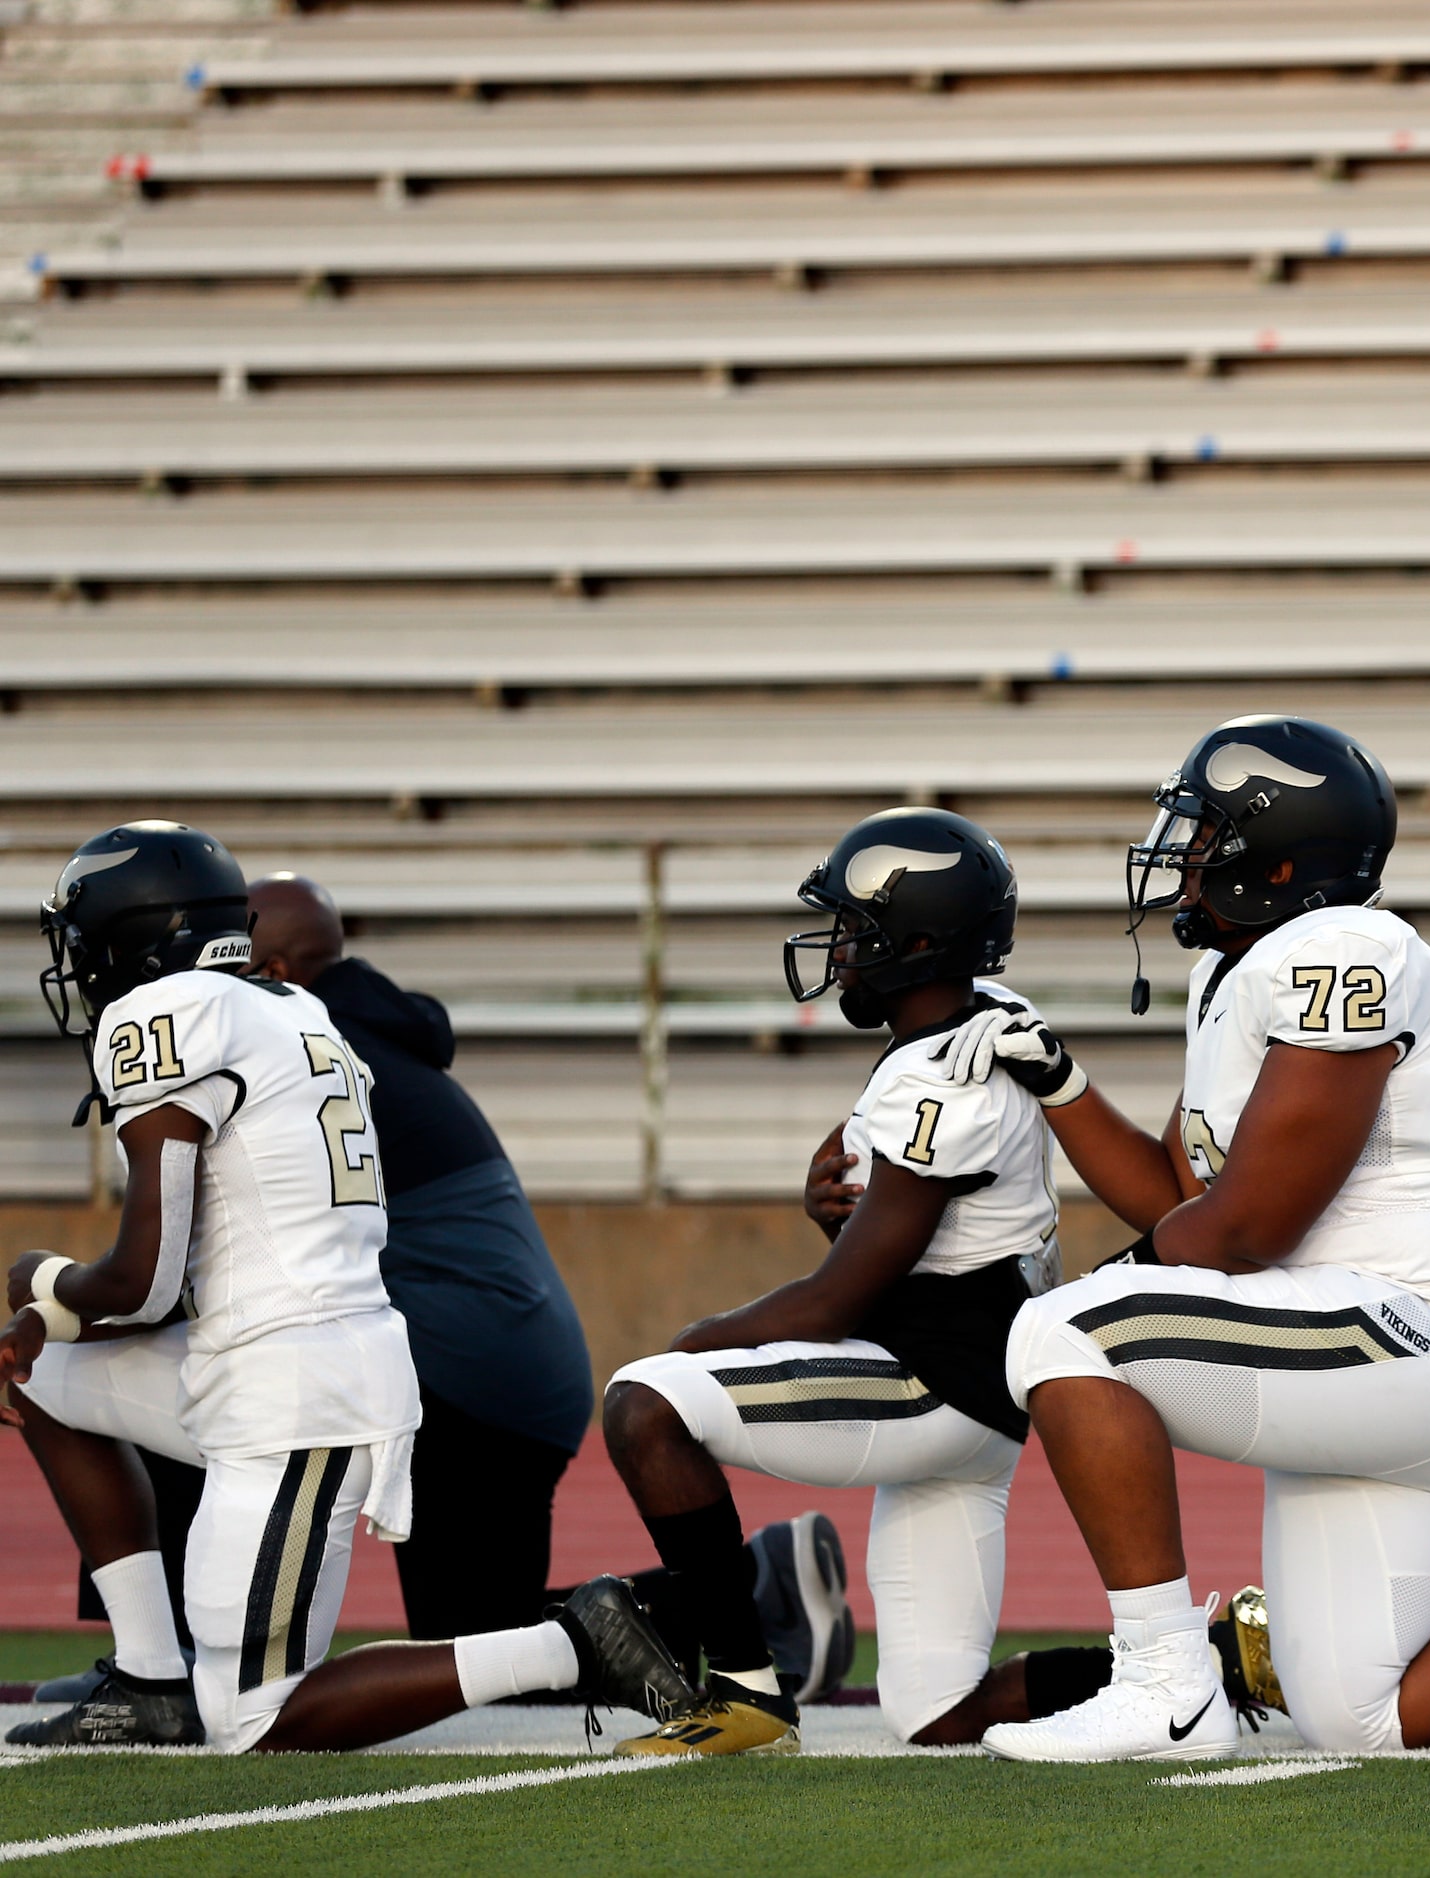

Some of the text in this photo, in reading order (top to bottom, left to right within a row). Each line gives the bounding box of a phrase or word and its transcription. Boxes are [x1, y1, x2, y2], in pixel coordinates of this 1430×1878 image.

[1291, 965, 1387, 1033] 72
[109, 1013, 186, 1091] 21
[902, 1098, 944, 1166] 1
[1381, 1301, 1430, 1353] VIKINGS
